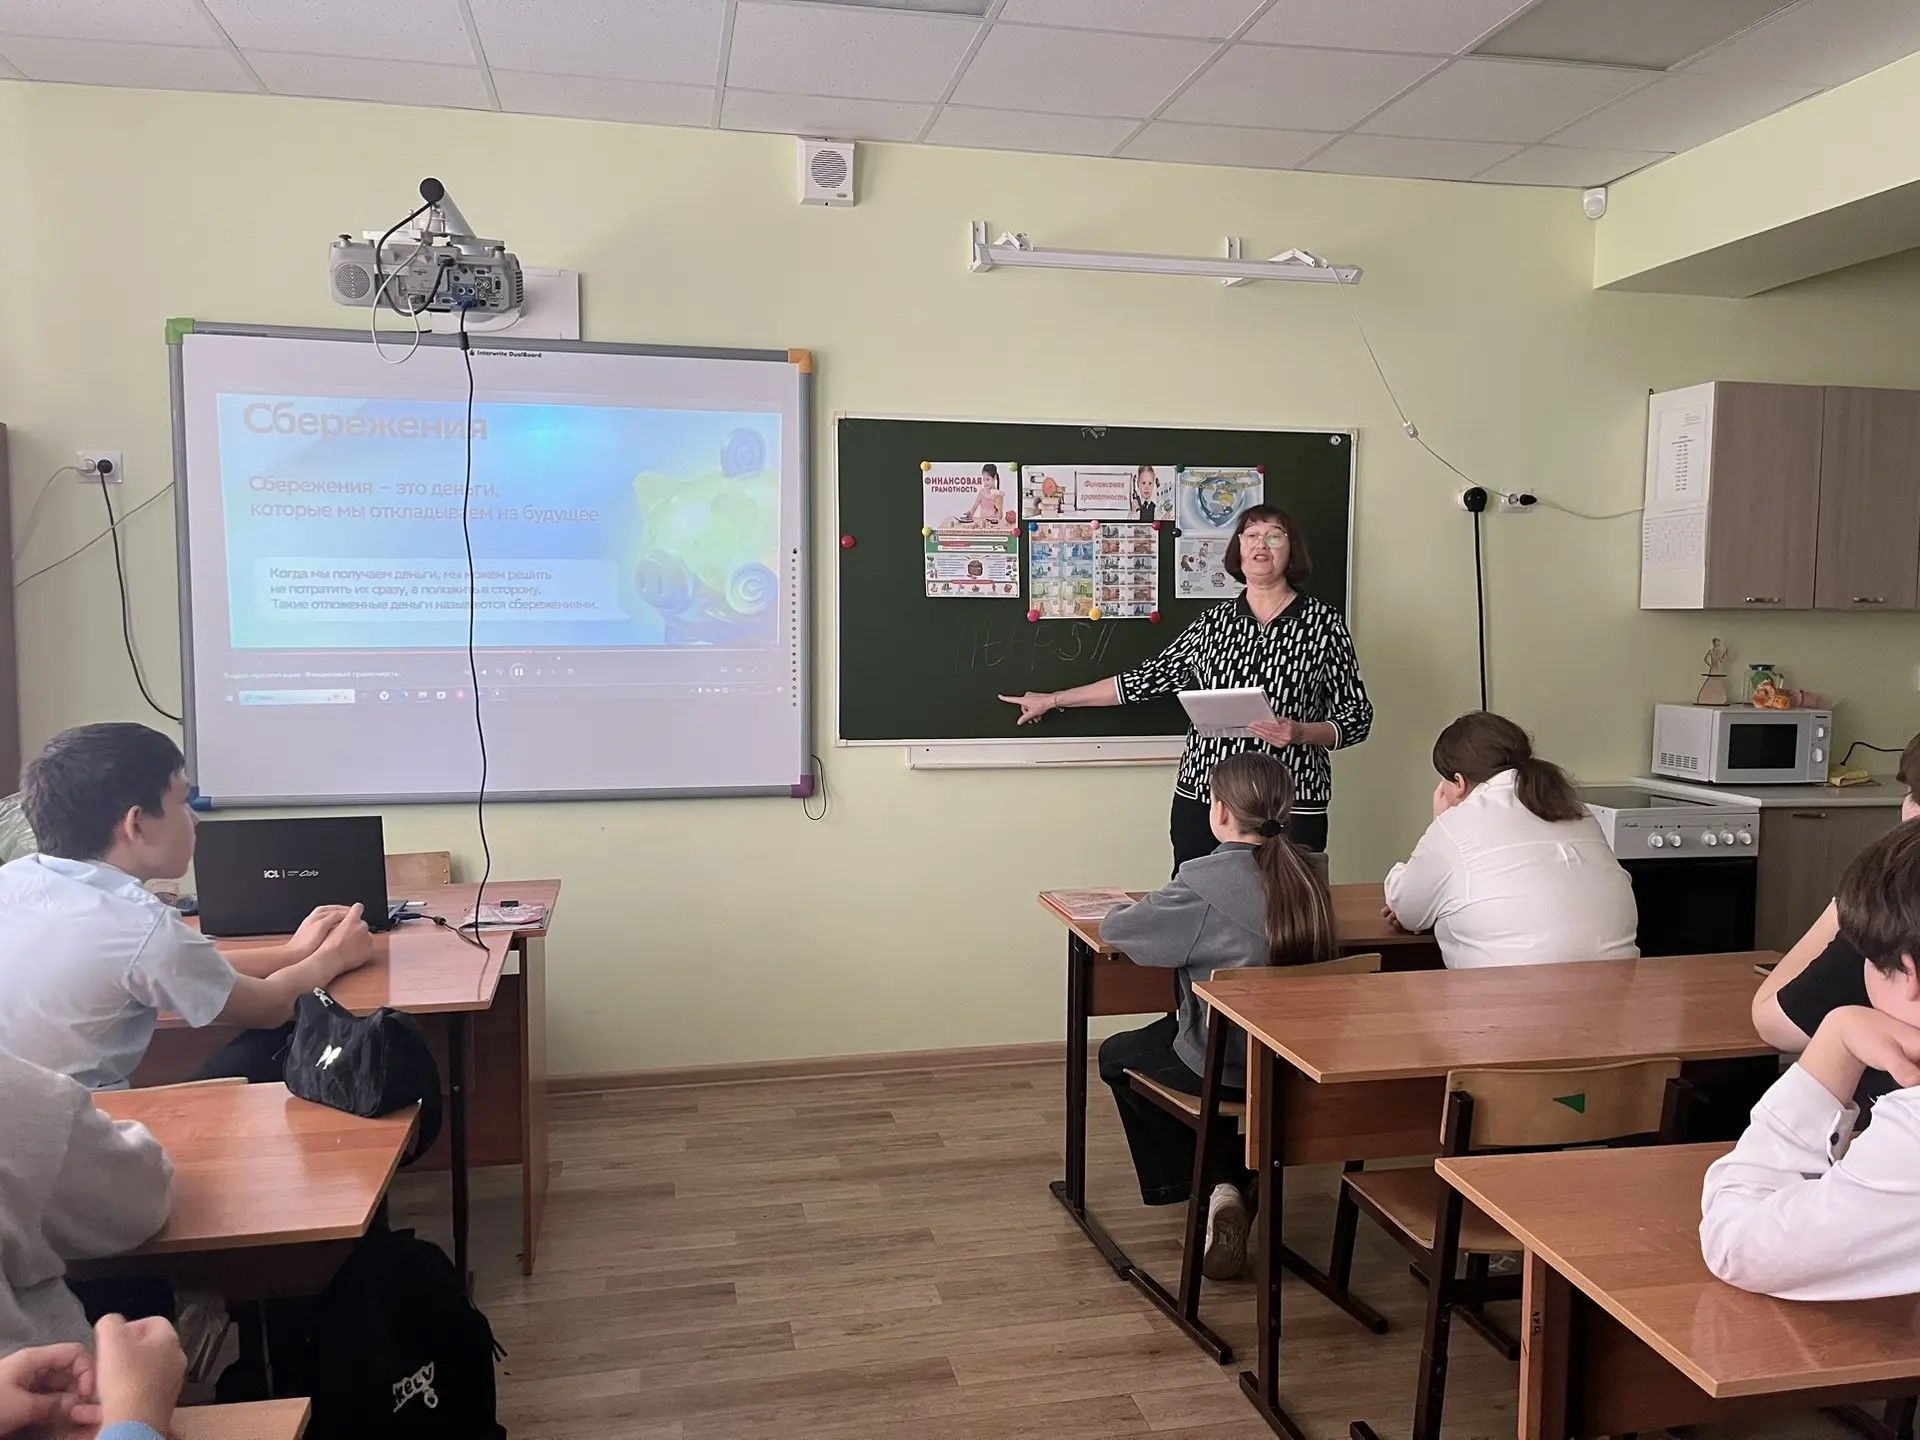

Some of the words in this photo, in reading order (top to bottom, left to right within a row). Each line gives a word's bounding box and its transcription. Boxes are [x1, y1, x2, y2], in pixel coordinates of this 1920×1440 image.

[243, 402, 488, 441] Сбережения
[249, 475, 373, 497] Сбережения
[396, 483, 427, 496] это
[924, 477, 983, 486] ФИНАНСОВАЯ
[1084, 480, 1125, 489] Финансовая
[931, 486, 978, 494] ГРАМОТНОСТЬ
[1081, 493, 1128, 503] грамотность
[251, 503, 332, 519] которые
[337, 504, 365, 518] мы
[498, 508, 519, 521] на
[523, 505, 600, 524] будущее
[270, 568, 307, 579] Когда
[311, 569, 329, 579] мы
[333, 569, 392, 580] получаем
[395, 569, 440, 582] деньги,
[444, 571, 461, 579] мы
[508, 571, 552, 581] решить
[271, 585, 286, 594] не
[289, 585, 350, 596] потратить
[355, 585, 369, 594] их
[372, 586, 409, 597] сразу,
[272, 599, 309, 609] Такие
[311, 600, 388, 610] отложенные
[390, 600, 433, 611] деньги
[436, 601, 507, 610] назывются
